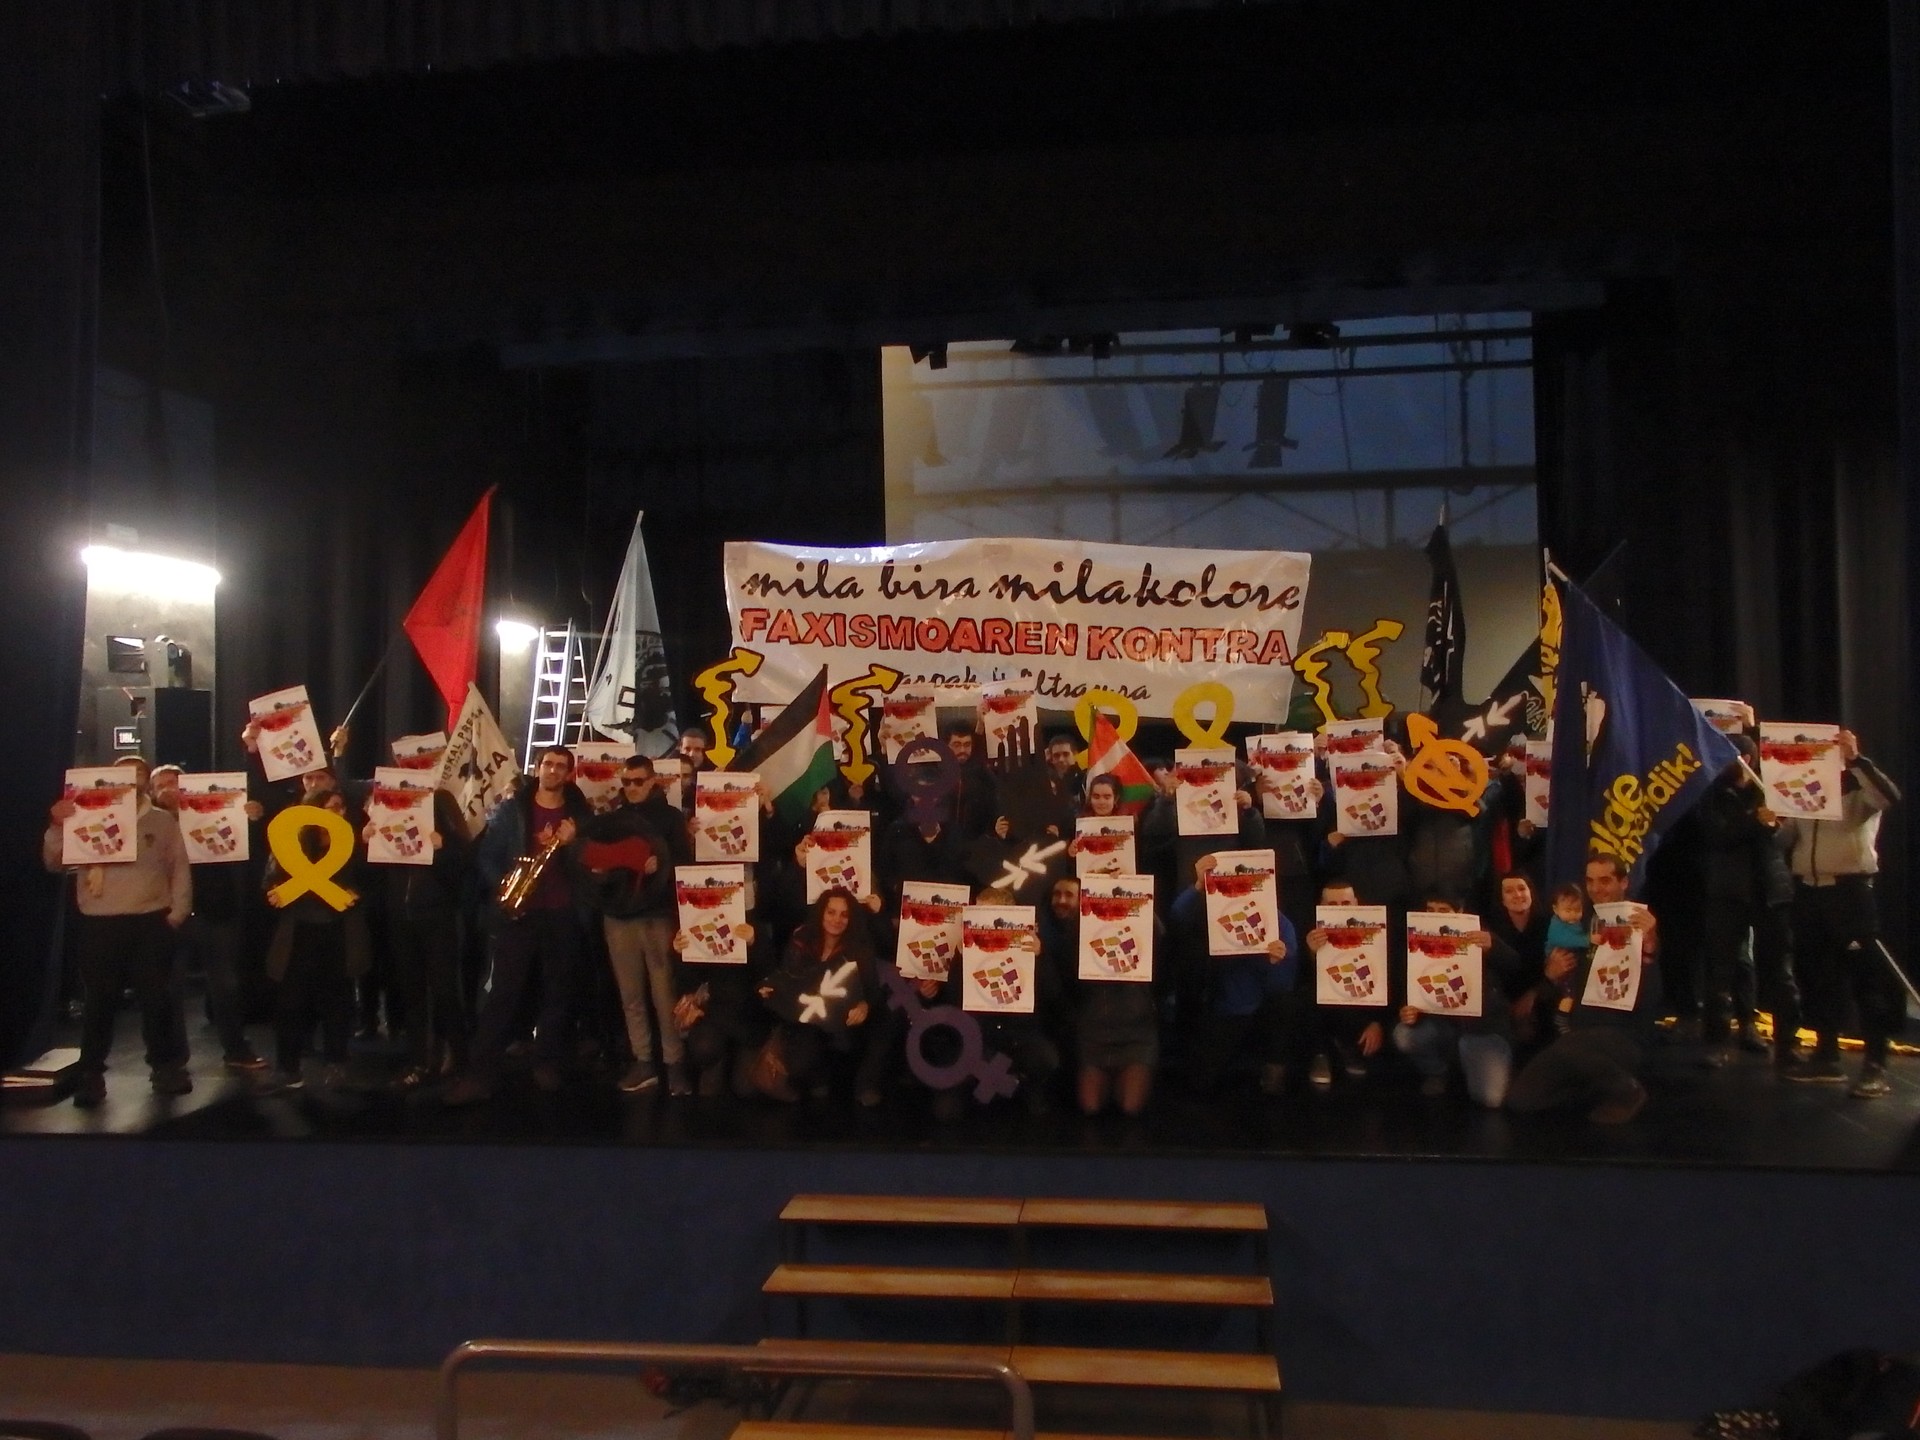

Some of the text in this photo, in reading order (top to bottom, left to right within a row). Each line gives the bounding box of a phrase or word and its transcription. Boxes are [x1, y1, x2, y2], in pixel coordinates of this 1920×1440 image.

[741, 559, 864, 599] mila
[739, 608, 1294, 666] FAXISMOAREN KONTRA
